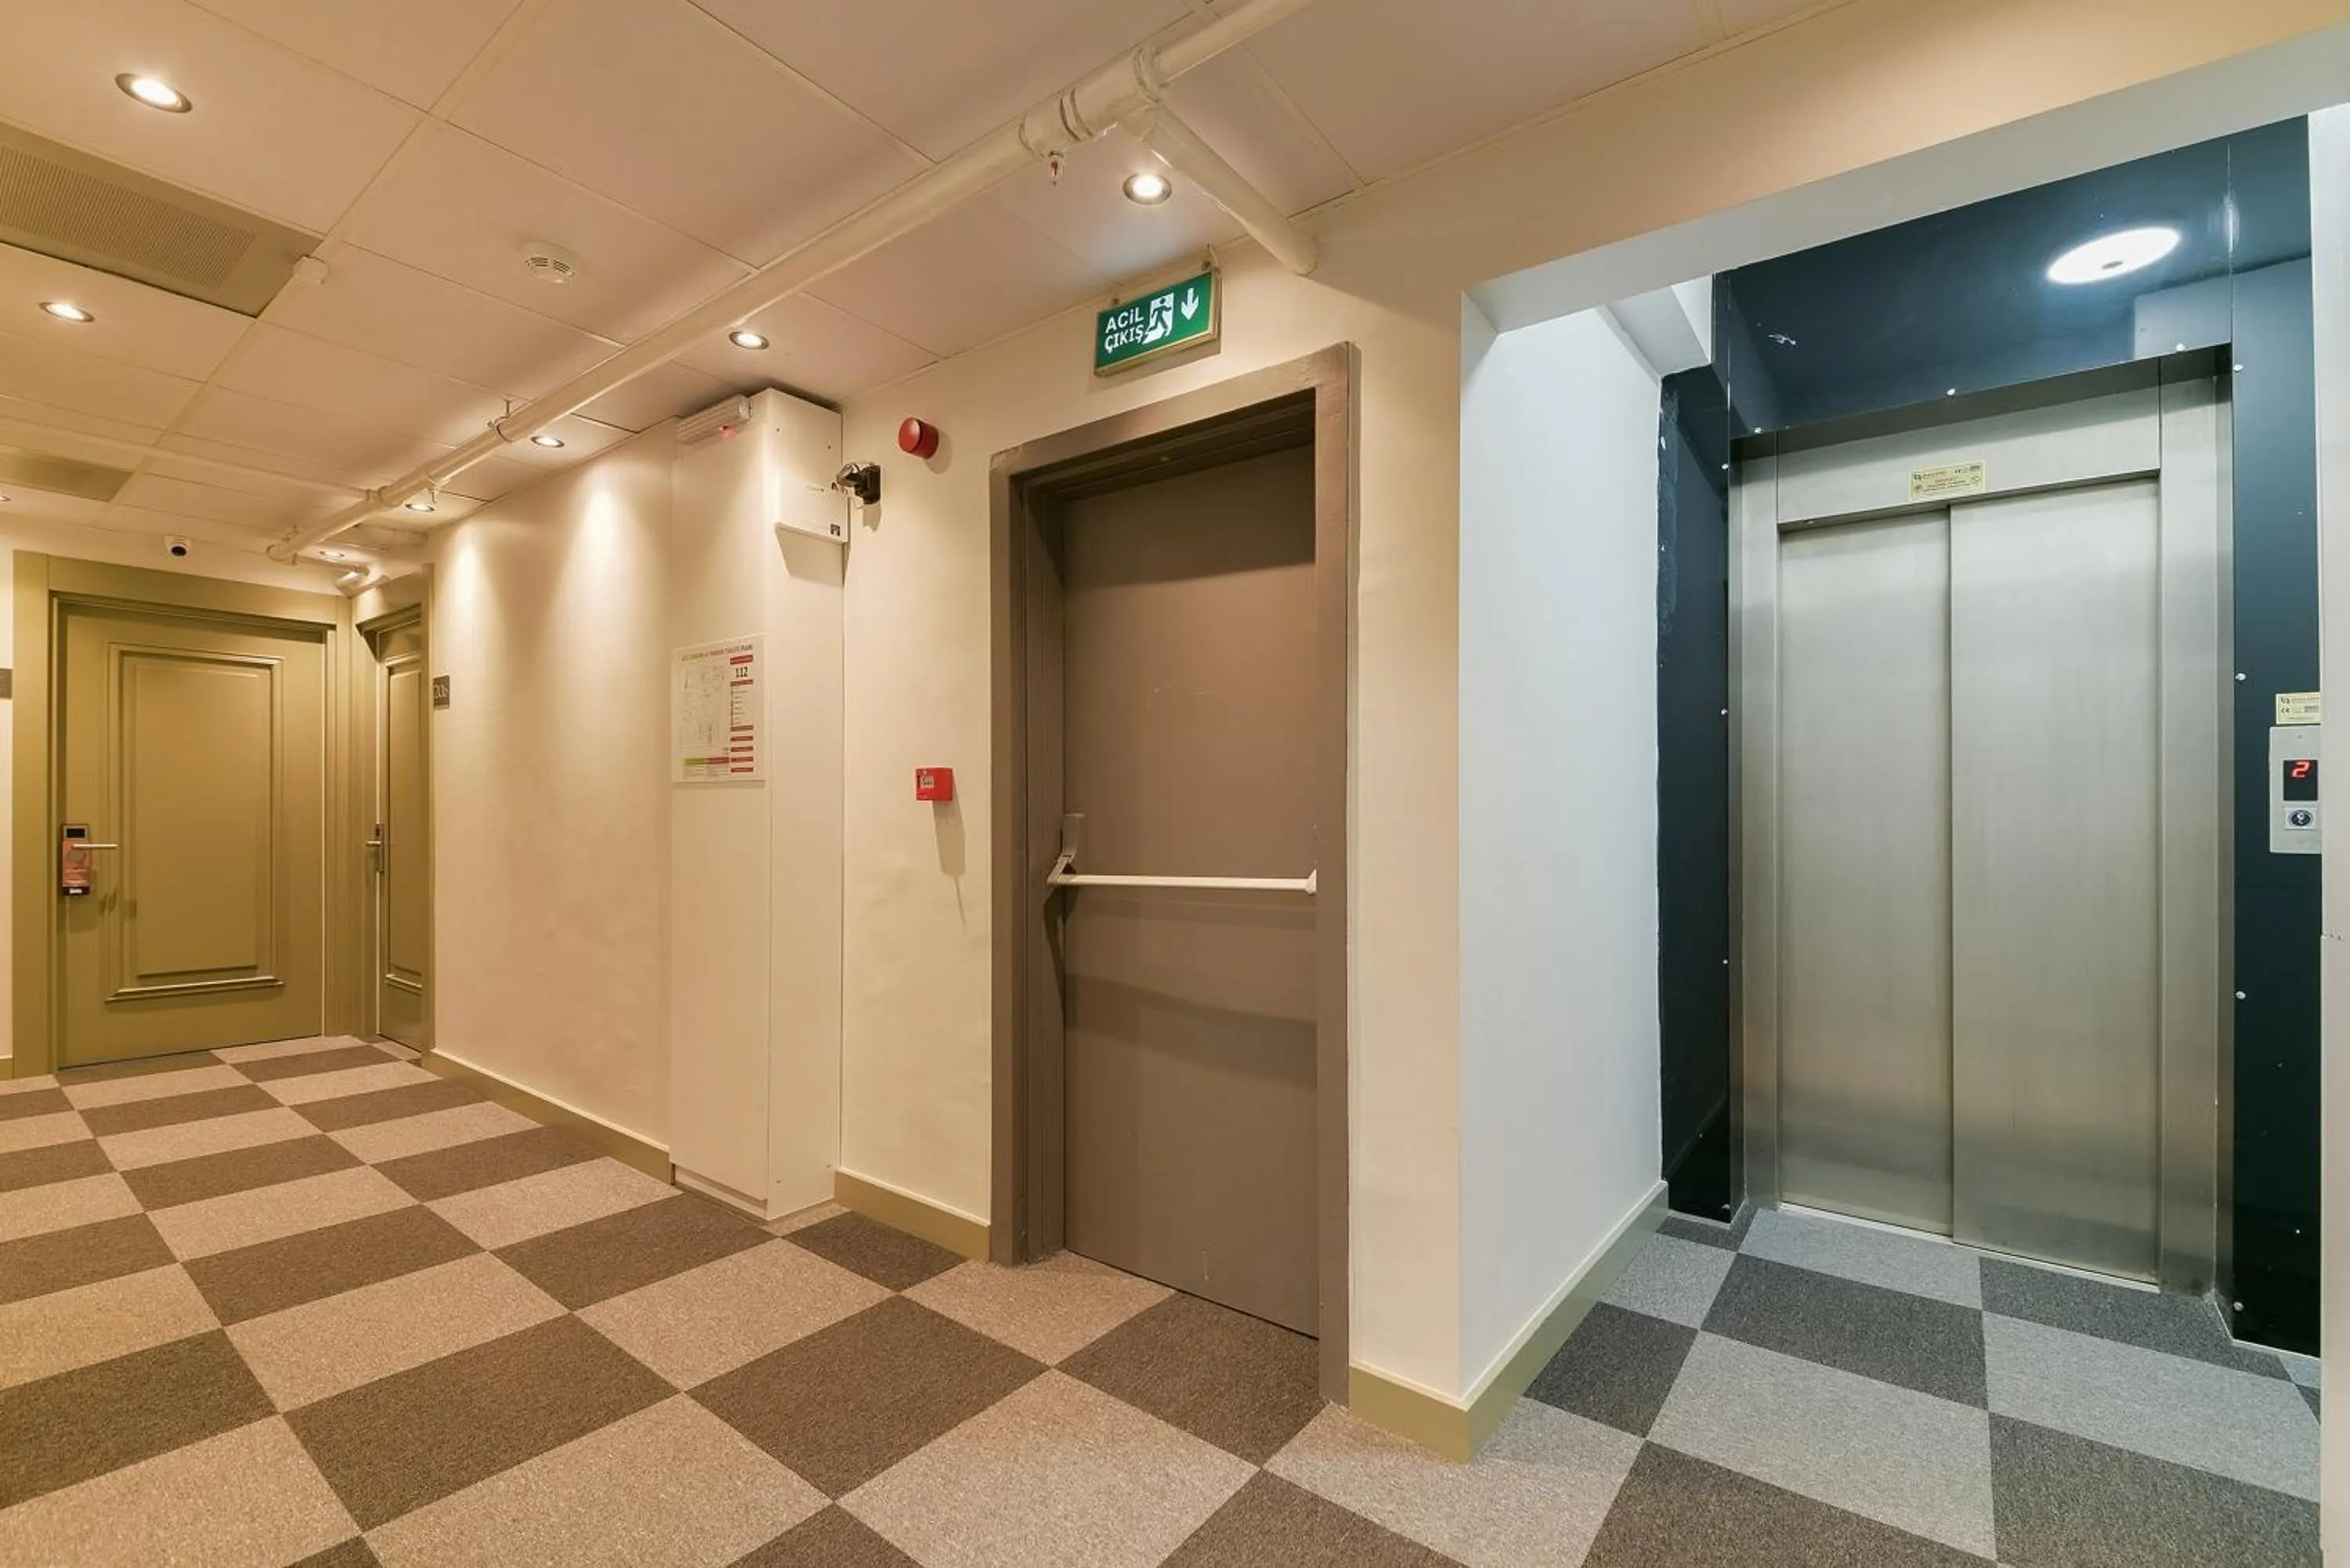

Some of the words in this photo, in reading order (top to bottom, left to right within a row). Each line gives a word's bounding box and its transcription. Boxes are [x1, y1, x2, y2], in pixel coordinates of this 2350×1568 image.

[1104, 324, 1144, 354] ÇIKIŞ
[736, 667, 748, 677] 112
[2292, 761, 2310, 778] 2
